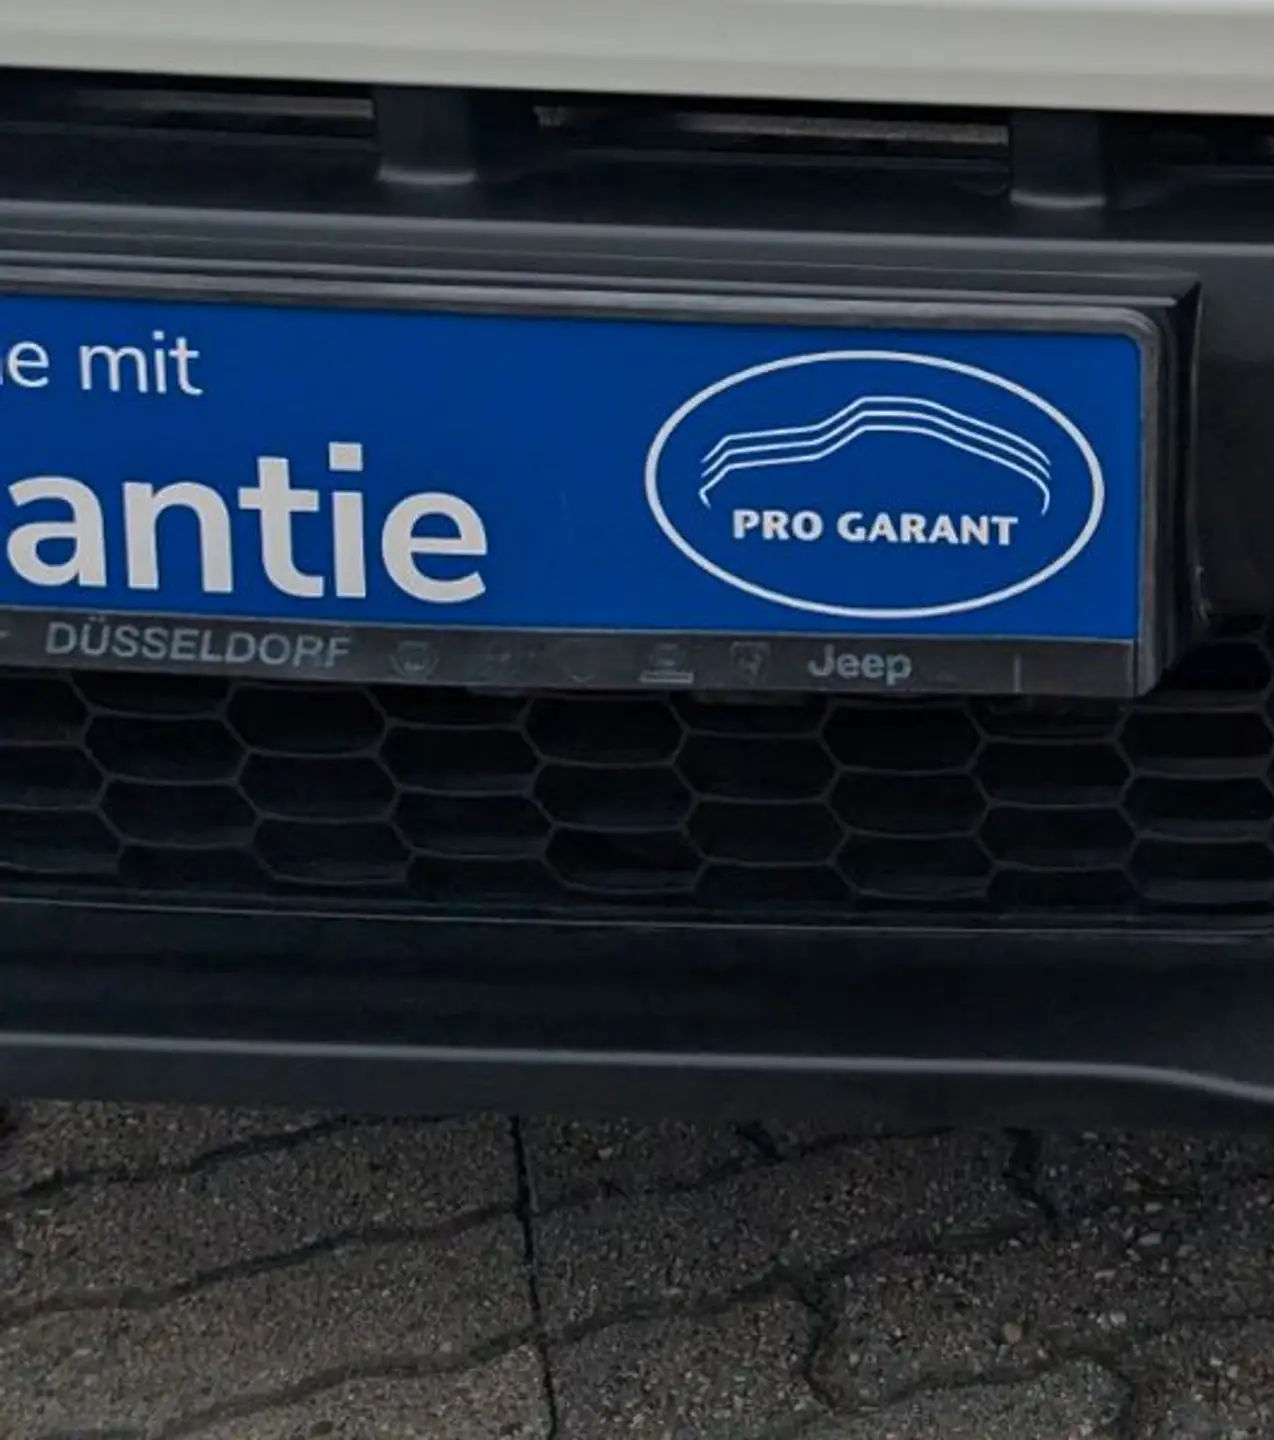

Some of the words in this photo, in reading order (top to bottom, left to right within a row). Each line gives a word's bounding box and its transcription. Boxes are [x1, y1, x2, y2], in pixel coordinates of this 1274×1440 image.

[79, 330, 204, 396] mit
[732, 509, 824, 541] PRO
[836, 511, 1019, 546] GARANT
[46, 616, 351, 668] DÜSSELDORF
[808, 644, 913, 687] Jeep
